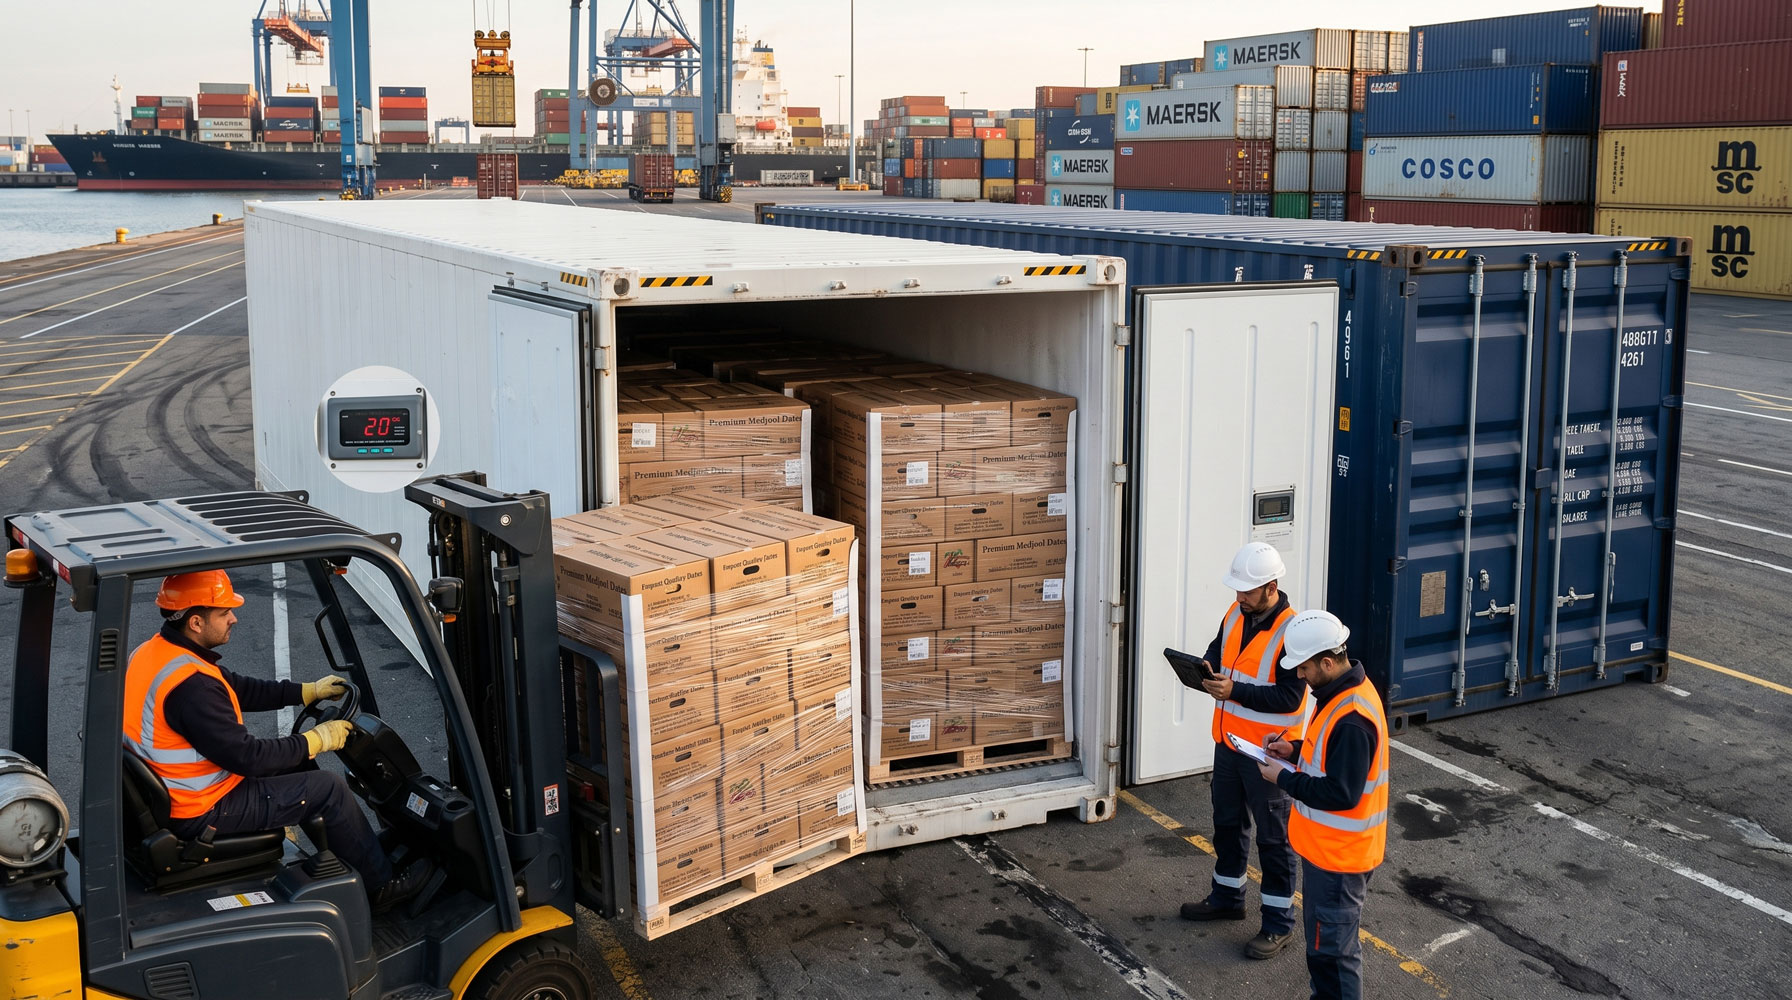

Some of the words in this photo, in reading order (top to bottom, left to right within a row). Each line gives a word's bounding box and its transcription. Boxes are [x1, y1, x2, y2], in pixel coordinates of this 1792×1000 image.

[1233, 41, 1301, 65] MAERSK
[1146, 101, 1222, 125] MAERSK
[1063, 159, 1109, 173] MAERSK
[1402, 158, 1495, 180] COSCO
[1063, 194, 1108, 208] MAERSK
[1621, 351, 1644, 367] 4261
[364, 417, 391, 436] 20
[709, 418, 746, 426] Premium
[748, 416, 780, 425] Medjool
[634, 470, 673, 479] Premium
[982, 543, 1015, 553] Premium
[1016, 541, 1046, 549] Medjool
[1047, 538, 1067, 546] Dates
